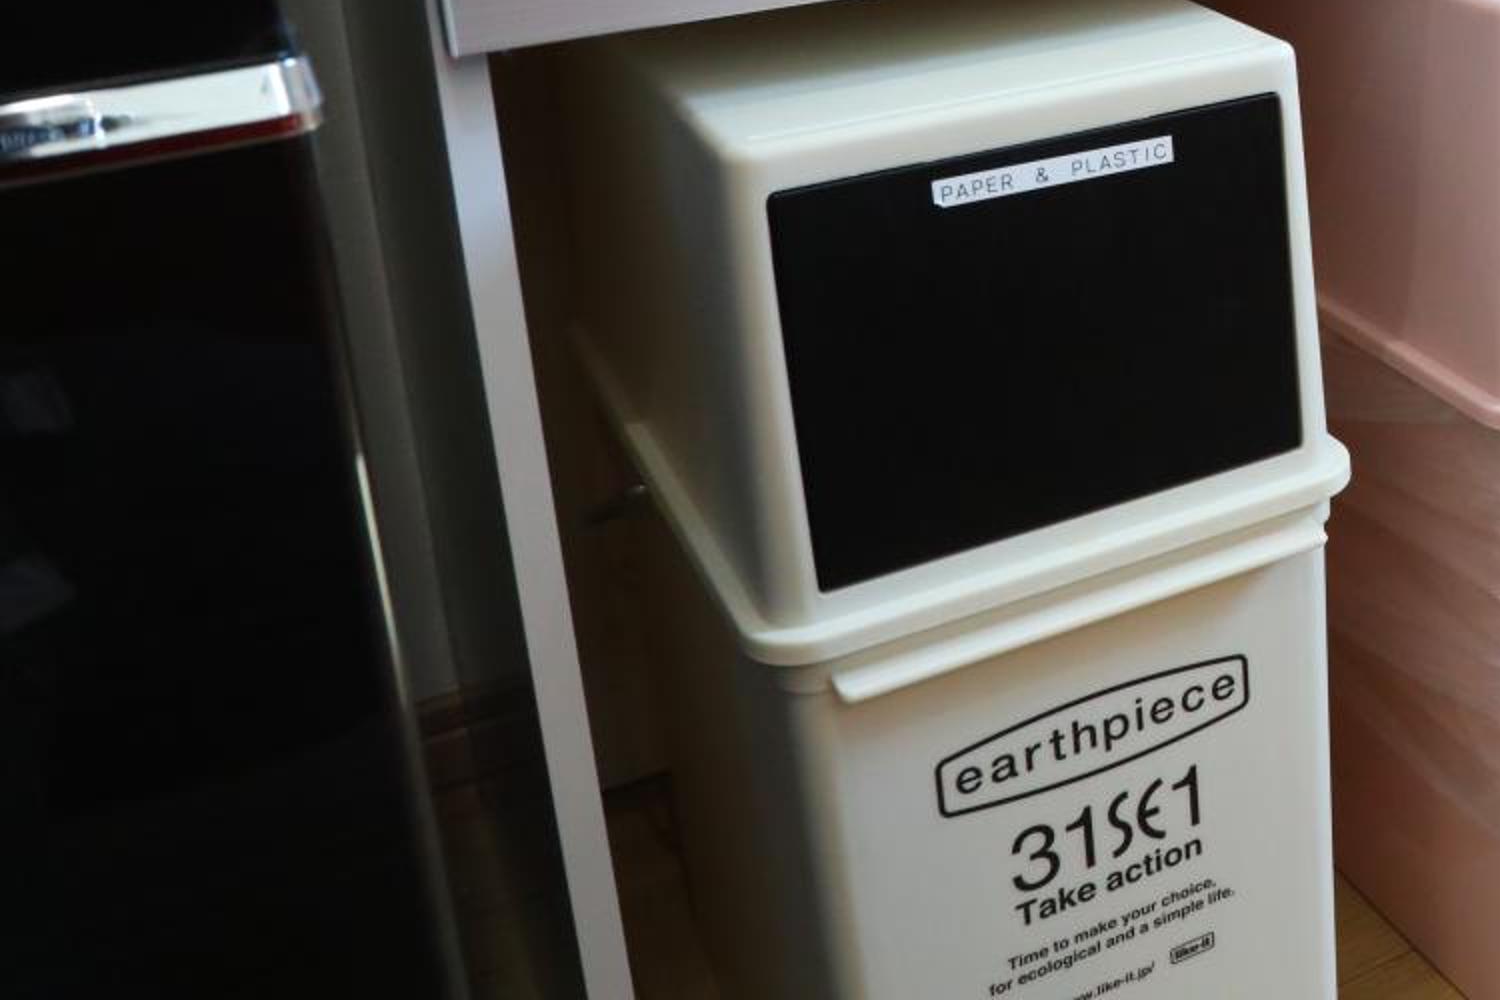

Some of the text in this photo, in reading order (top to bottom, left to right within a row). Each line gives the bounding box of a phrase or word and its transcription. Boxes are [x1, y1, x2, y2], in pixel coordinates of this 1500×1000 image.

[940, 143, 1167, 202] PAPER & PLASTIC
[954, 673, 1236, 795] earthpiece
[1007, 877, 1217, 970] Time to make your choice.
[1014, 838, 1203, 927] Take action
[988, 979, 1014, 998] for
[1017, 943, 1101, 986] ecological
[1105, 927, 1136, 949] and
[1138, 922, 1150, 935] a
[1152, 899, 1204, 929] simple
